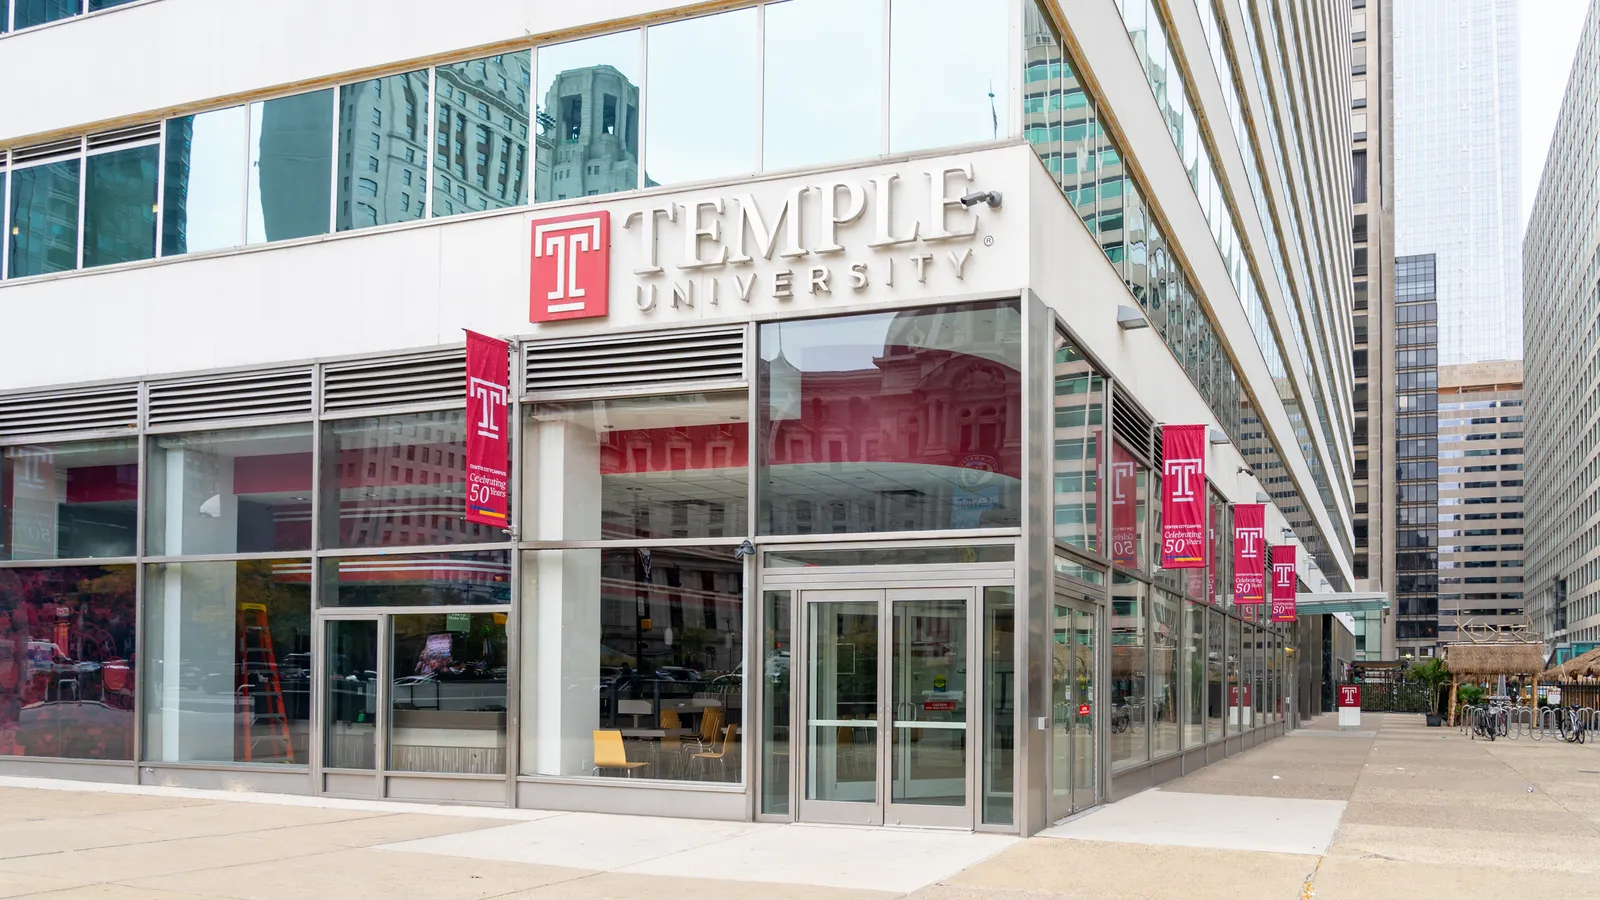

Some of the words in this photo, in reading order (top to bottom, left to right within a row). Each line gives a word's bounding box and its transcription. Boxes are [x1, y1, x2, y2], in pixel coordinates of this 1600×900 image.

[622, 162, 980, 276] TEMPLE
[534, 216, 601, 314] T
[635, 247, 973, 313] UNIVERSITY
[469, 375, 507, 440] T
[469, 472, 507, 490] Celebrating
[1165, 458, 1202, 502] T
[469, 483, 490, 504] 50
[490, 487, 507, 498] Years
[1164, 531, 1202, 539] Celebrating
[1164, 538, 1185, 554] 50
[1236, 527, 1263, 558] T
[1273, 563, 1295, 587] T
[1235, 583, 1250, 594] 50
[1272, 605, 1285, 614] 50
[1341, 686, 1358, 704] T
